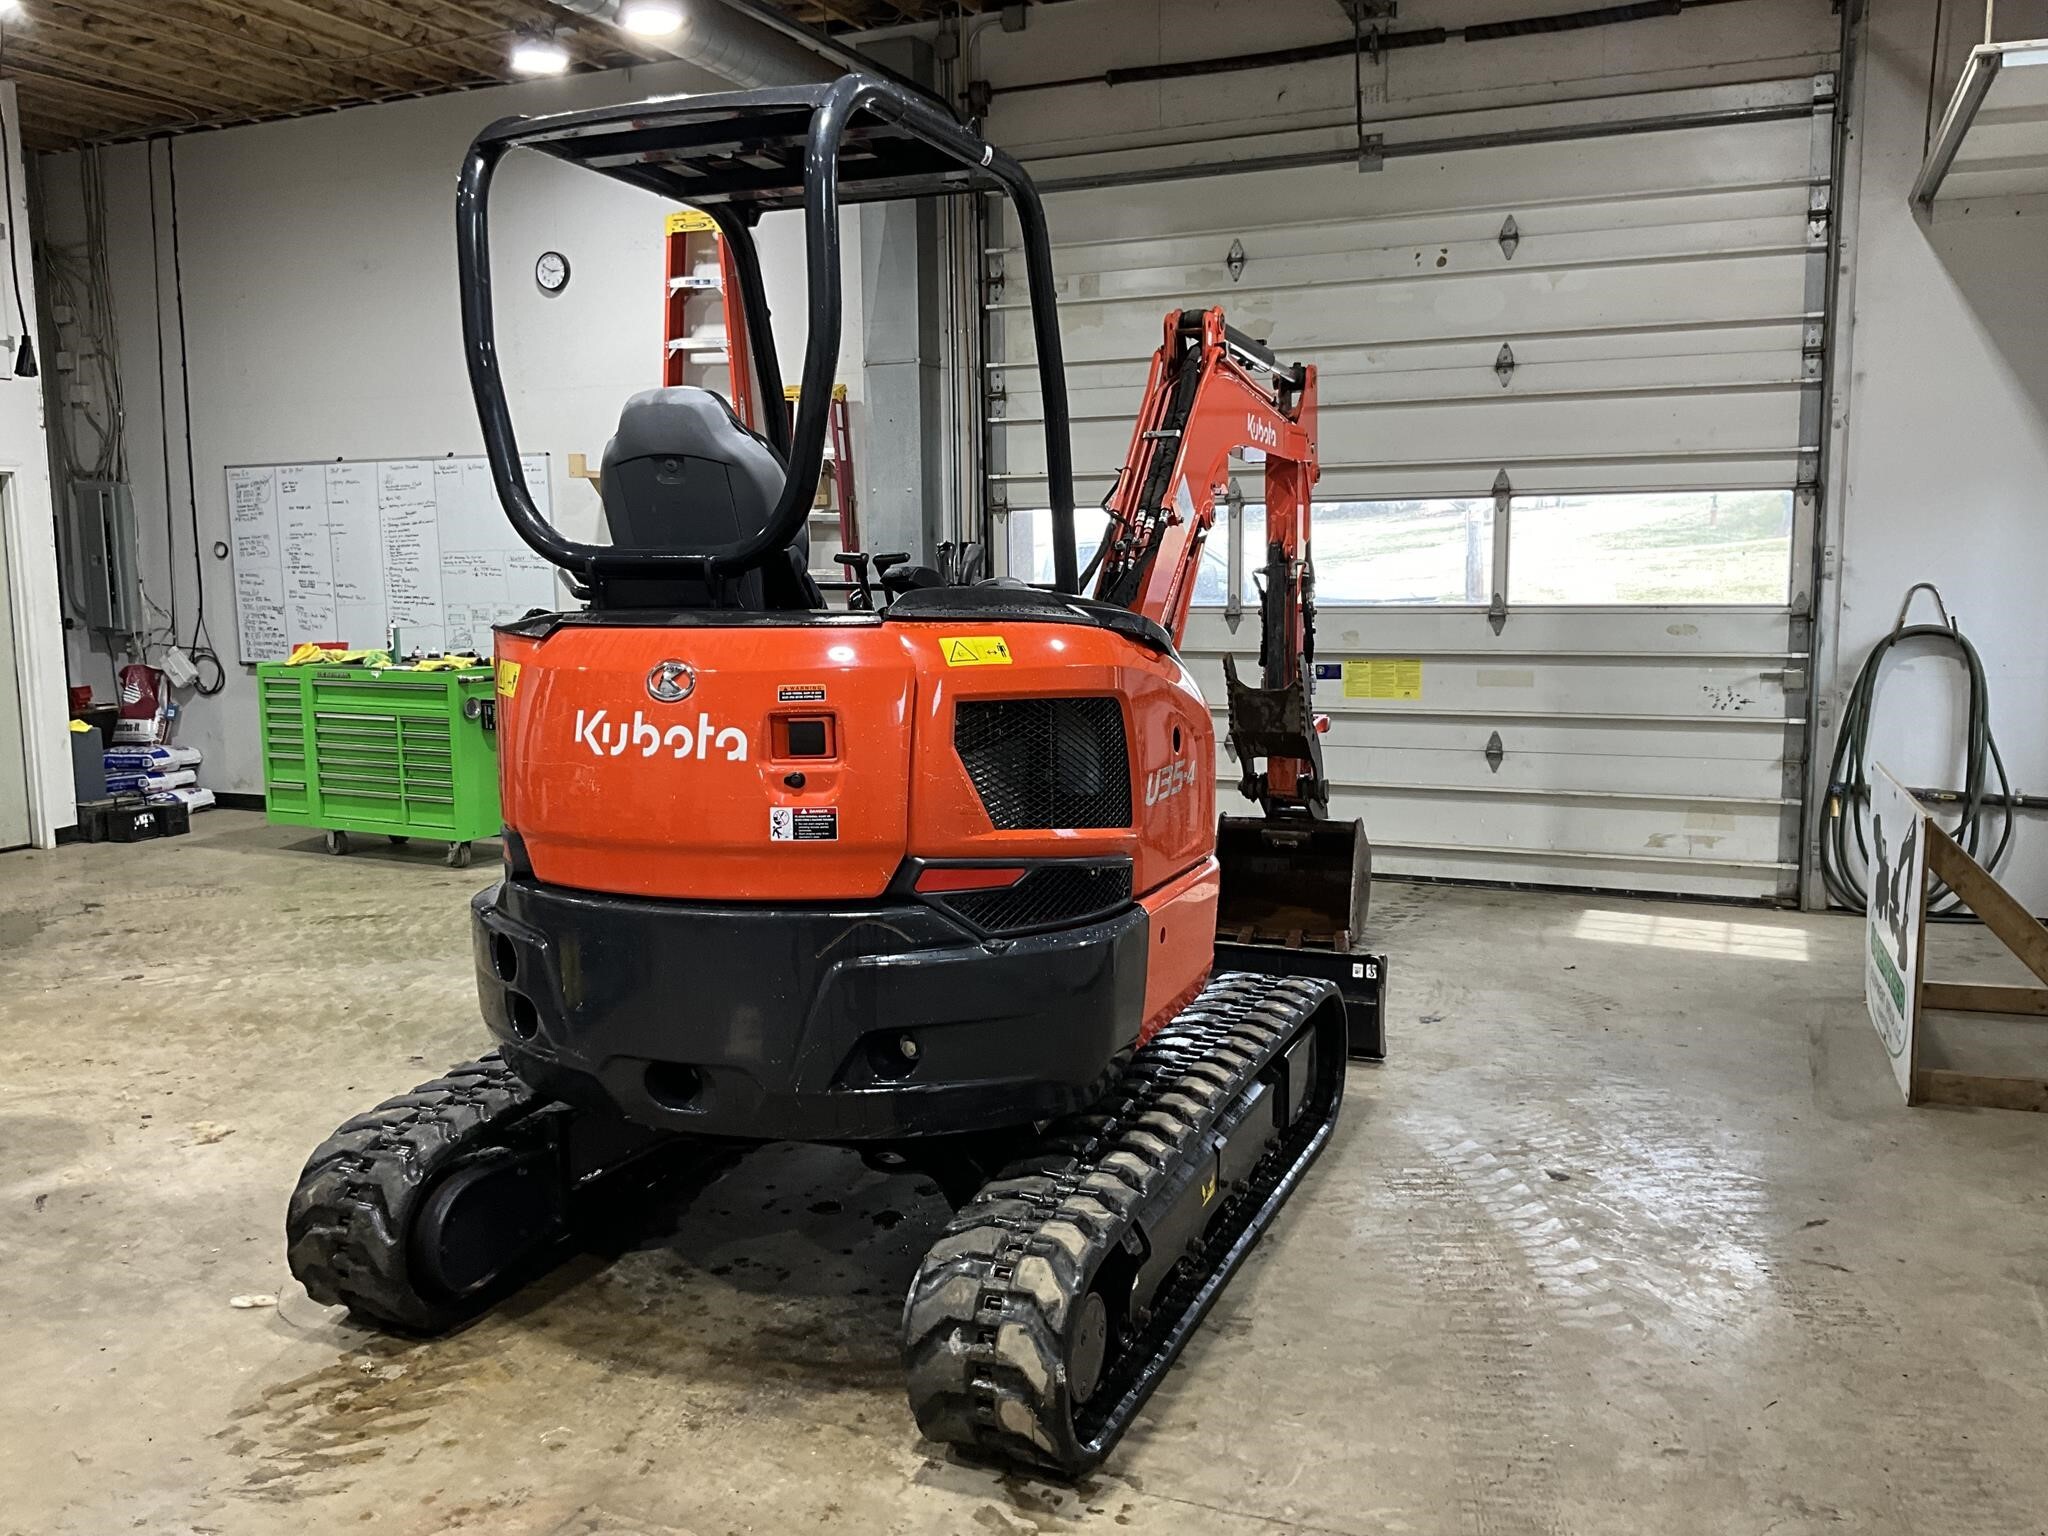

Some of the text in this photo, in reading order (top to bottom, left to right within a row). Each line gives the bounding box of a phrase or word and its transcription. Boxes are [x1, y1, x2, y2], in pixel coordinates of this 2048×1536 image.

[1247, 412, 1277, 447] Kubota
[575, 709, 748, 762] Kubota
[1145, 759, 1196, 806] U35-4
